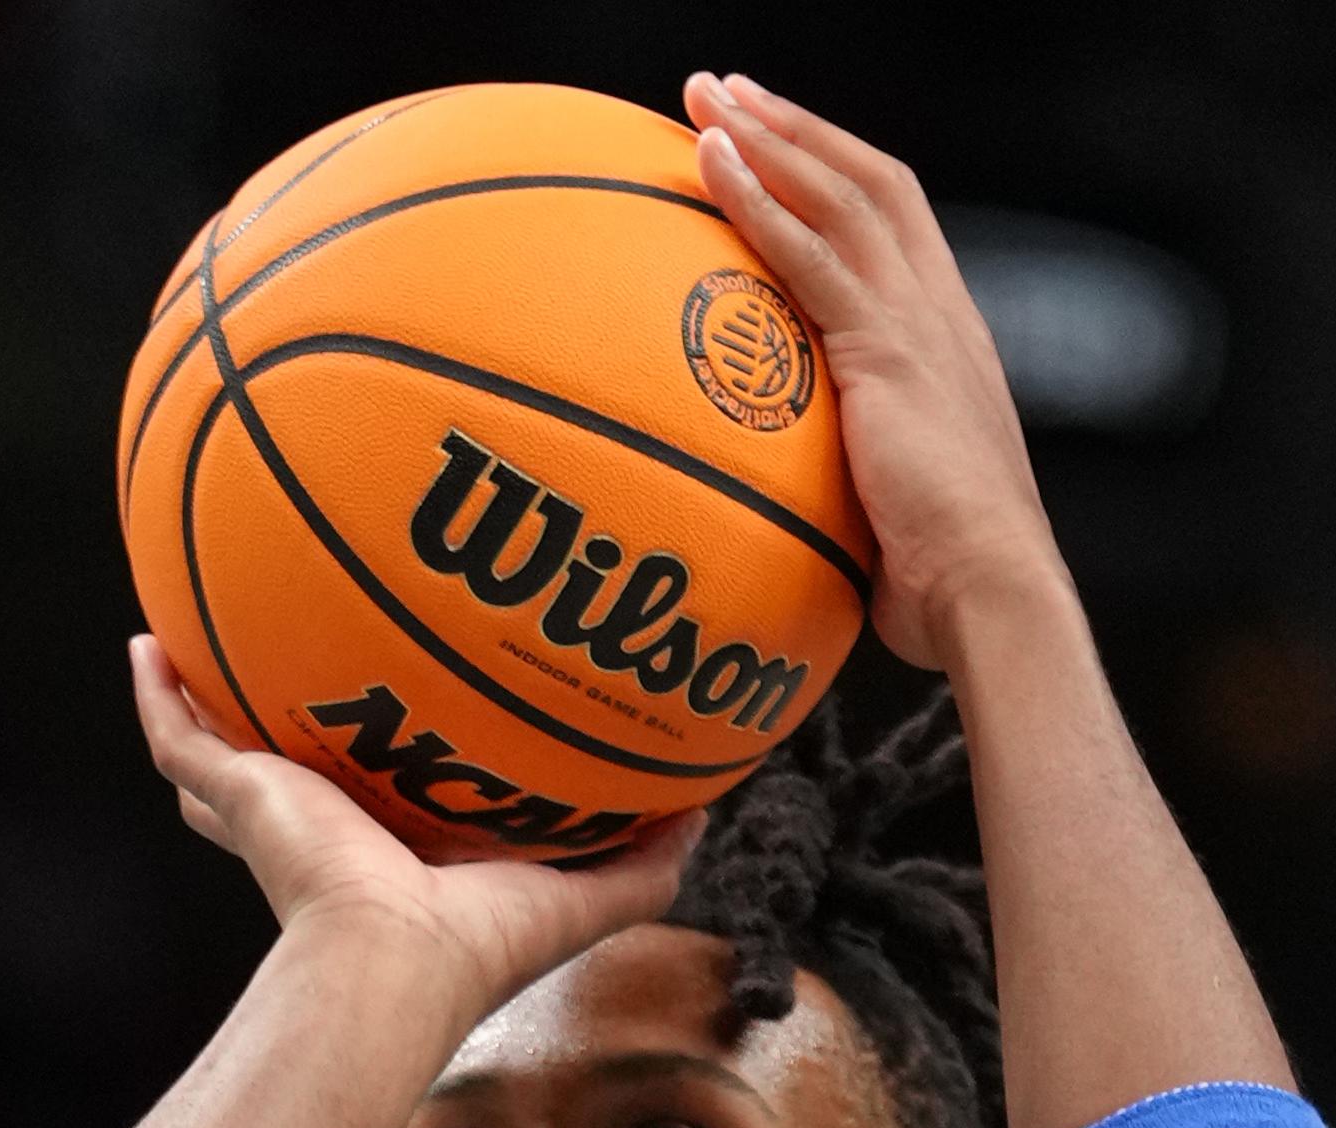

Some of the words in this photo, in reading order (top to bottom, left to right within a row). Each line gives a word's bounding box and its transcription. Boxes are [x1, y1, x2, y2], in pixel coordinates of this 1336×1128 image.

[410, 427, 811, 734] Wilson
[498, 639, 582, 688] INDOOR
[586, 687, 639, 720] GAME
[305, 684, 645, 848] NCAA
